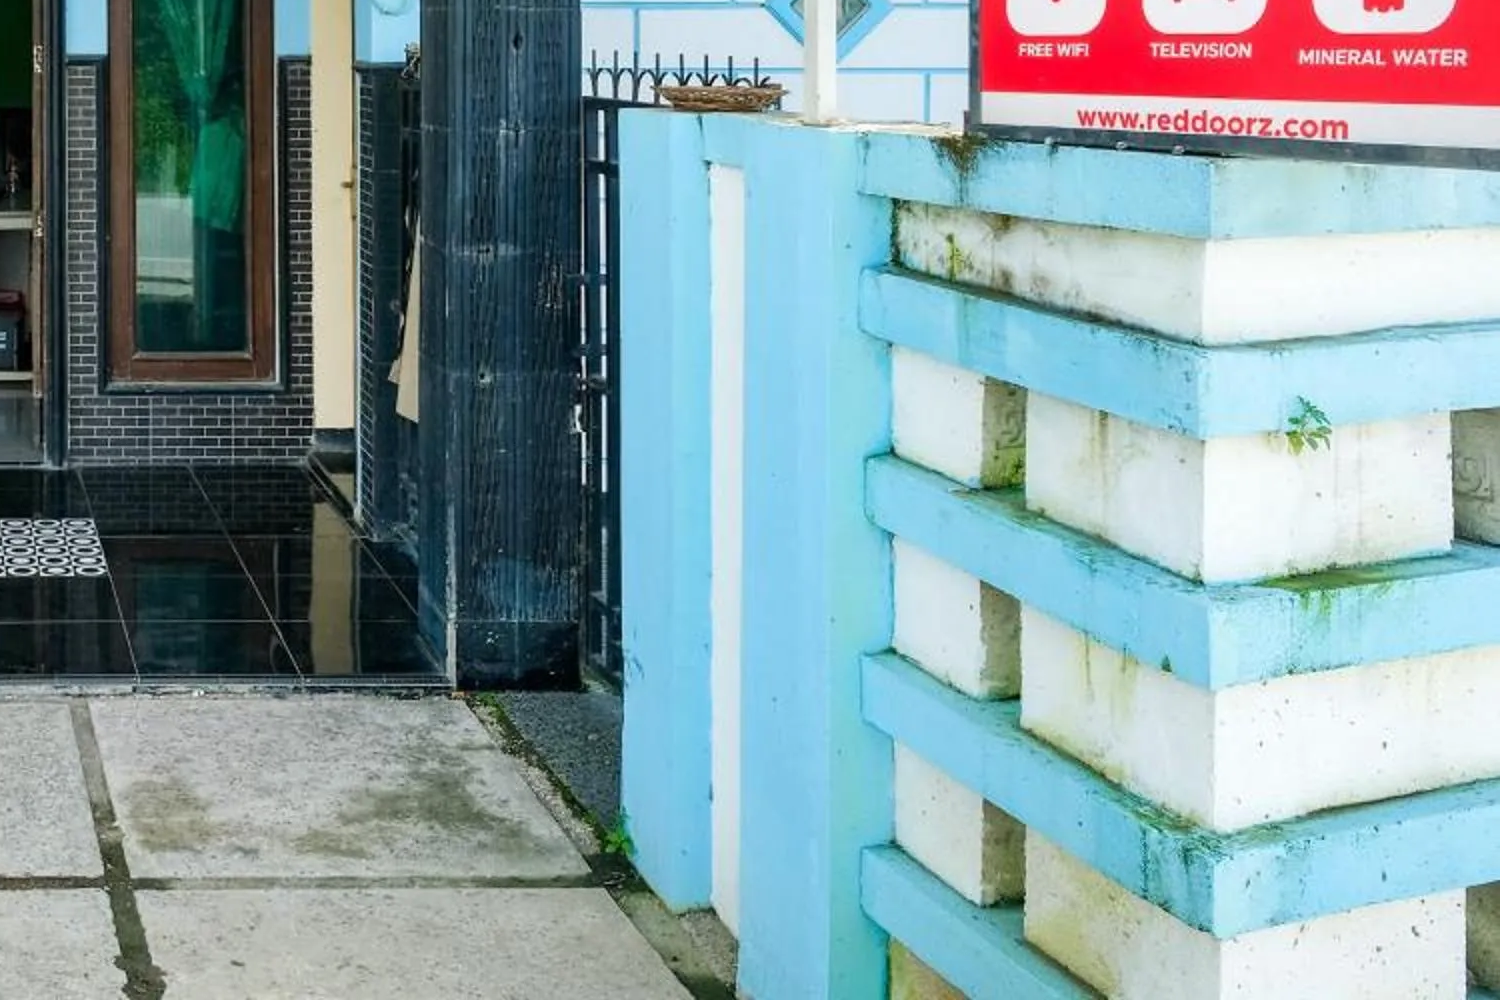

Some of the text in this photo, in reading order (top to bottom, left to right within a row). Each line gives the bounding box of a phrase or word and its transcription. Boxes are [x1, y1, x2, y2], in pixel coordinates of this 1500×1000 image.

[1018, 43, 1090, 58] FREE WIFI
[1150, 42, 1252, 59] TELEVISION
[1299, 48, 1468, 67] MINERAL WATER
[1077, 107, 1350, 140] www.reddoorz.com
